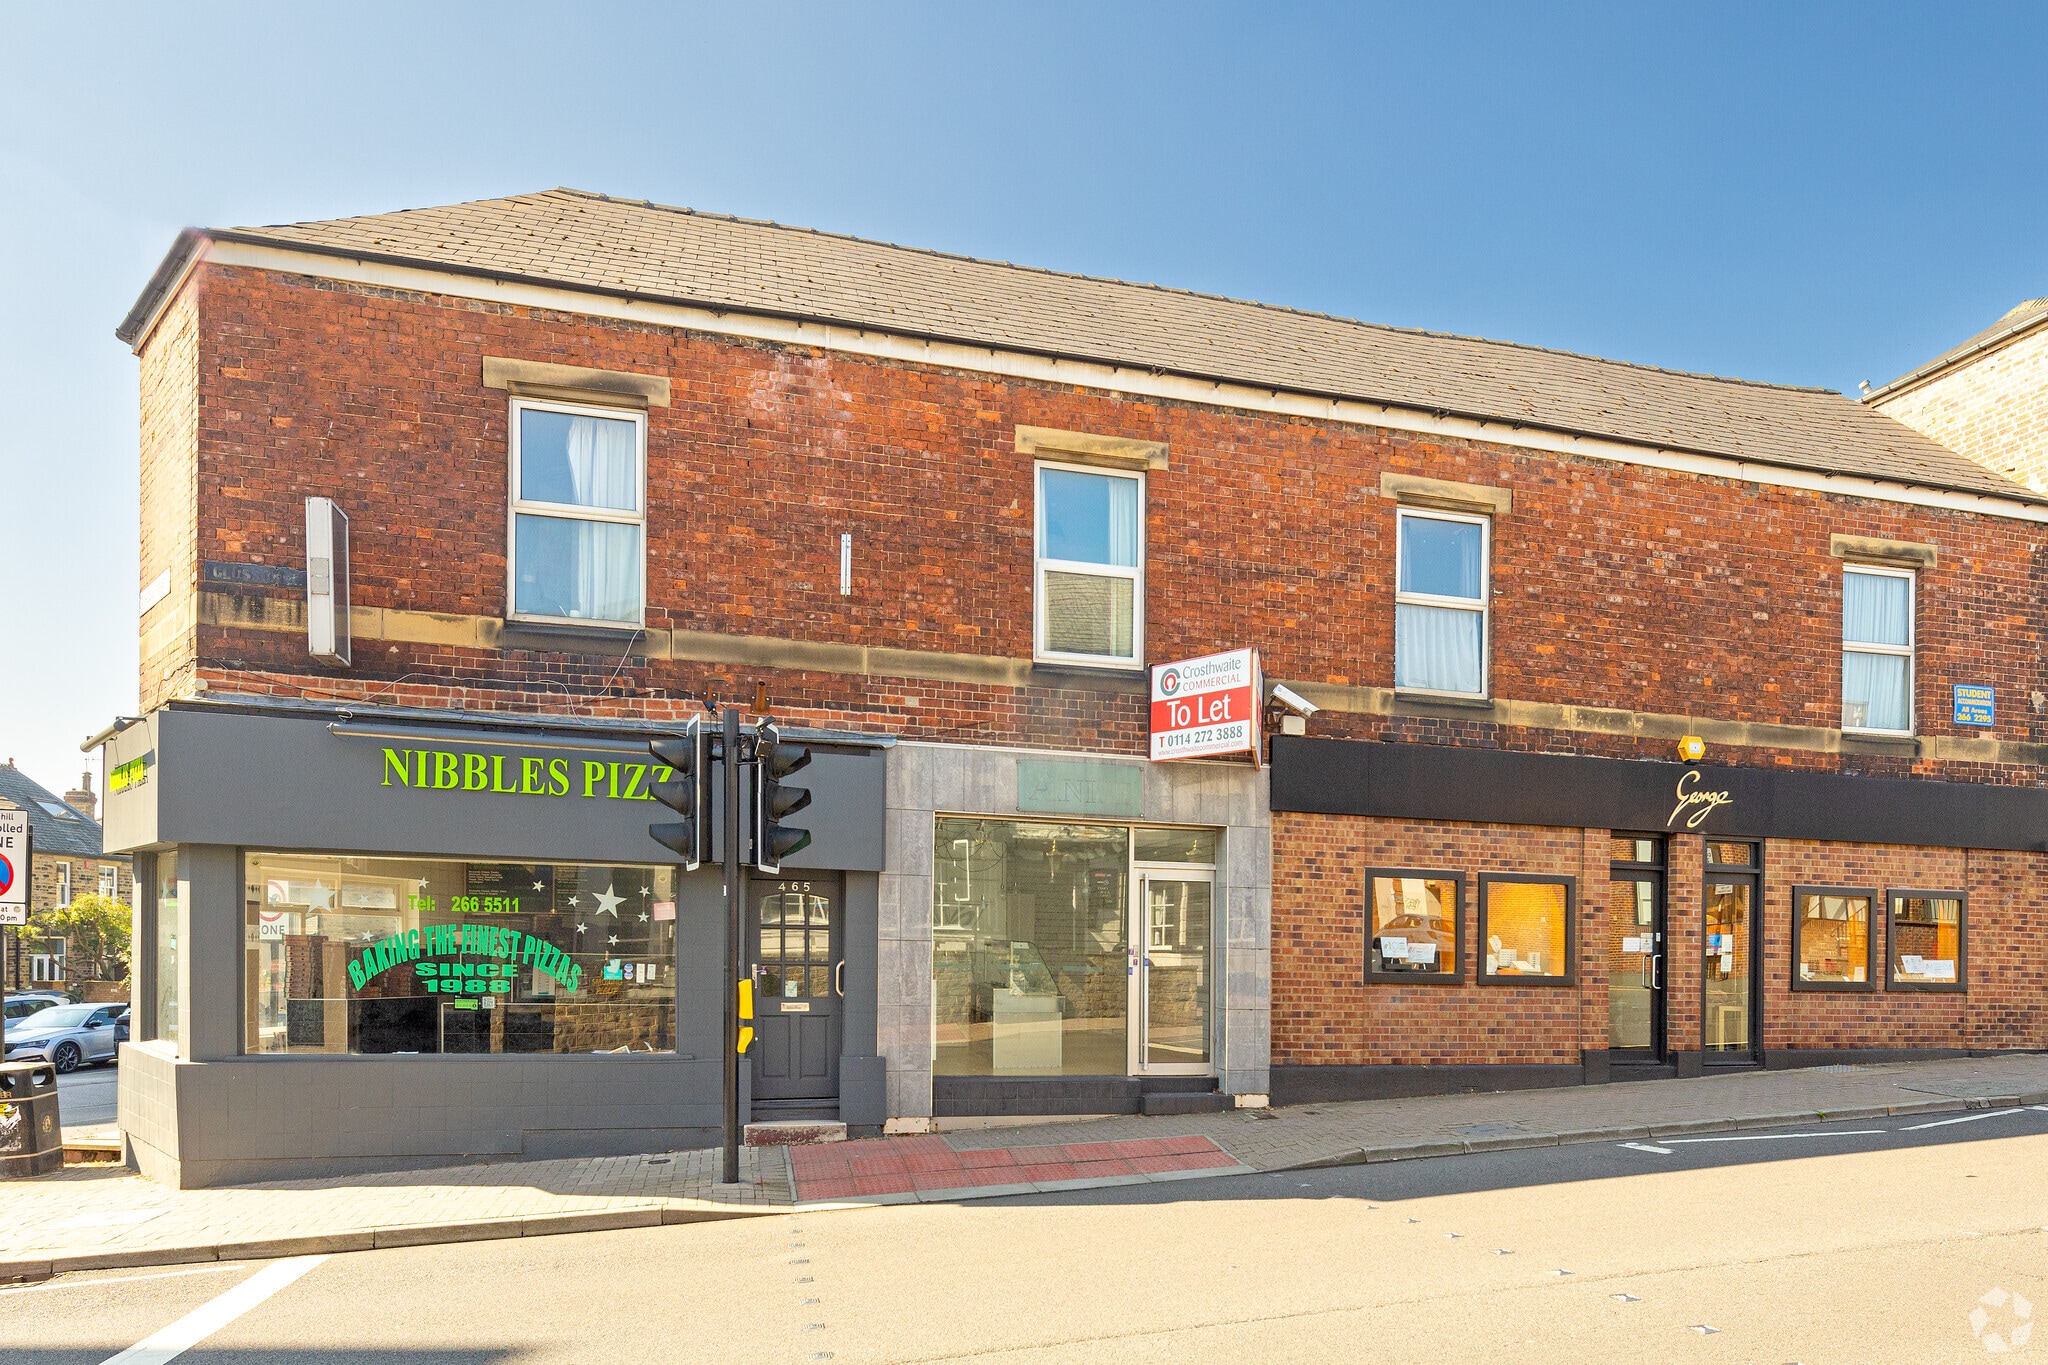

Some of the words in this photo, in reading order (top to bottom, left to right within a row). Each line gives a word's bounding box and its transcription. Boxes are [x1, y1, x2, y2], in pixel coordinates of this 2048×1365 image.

[1182, 657, 1242, 679] Crosthwaite
[1182, 673, 1242, 692] COMMERCIAL
[1957, 688, 1992, 699] STUDENT
[1166, 699, 1191, 728] To
[1198, 693, 1232, 724] Let
[1957, 713, 1971, 721] 266
[1973, 714, 1992, 723] 2295
[1159, 736, 1165, 748] T
[1167, 733, 1191, 747] 0114
[1194, 730, 1213, 744] 272
[1216, 725, 1243, 741] 3888
[1157, 739, 1243, 756] www.crosthwaitecommercial.com
[381, 748, 570, 797] NIBBLES
[1666, 770, 1734, 828] George
[778, 881, 811, 892] 465
[407, 895, 436, 912] Tel:
[451, 896, 480, 913] 266
[483, 897, 520, 914] 5511
[347, 928, 421, 992] BAKING
[423, 923, 457, 957] THE
[461, 923, 522, 961] FINEST
[522, 935, 583, 994] PIZZAS
[415, 961, 519, 978] SINCE
[421, 979, 511, 994] 1988
